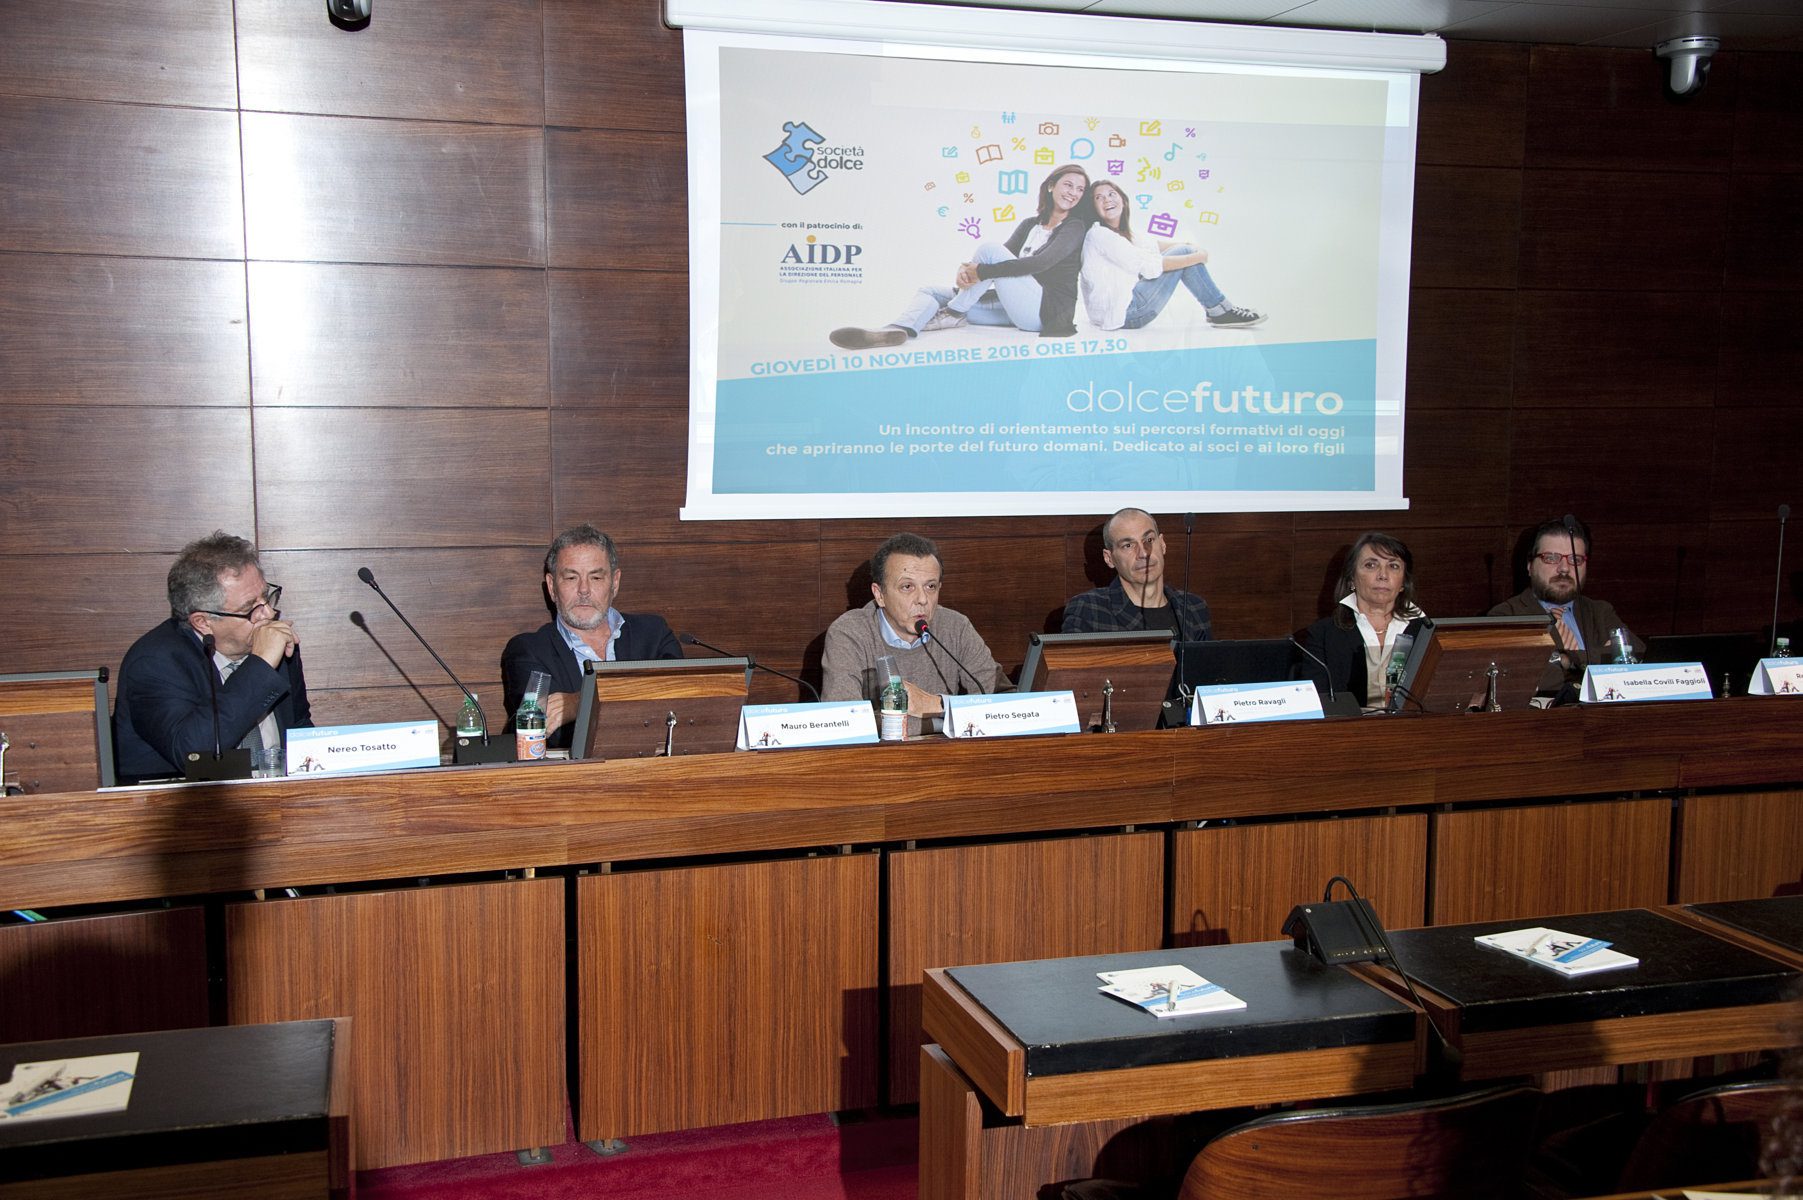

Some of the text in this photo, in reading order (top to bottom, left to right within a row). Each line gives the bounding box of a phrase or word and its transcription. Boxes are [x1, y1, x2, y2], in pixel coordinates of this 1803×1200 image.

[817, 146, 864, 157] società
[816, 156, 864, 170] dolce
[806, 222, 851, 230] patrocinio
[780, 235, 862, 265] AIDP
[750, 354, 837, 376] GIOVEDÌ
[842, 356, 864, 370] 10
[869, 347, 983, 368] NOVEMBRE
[987, 344, 1030, 360] 2016
[1035, 341, 1076, 356] ORE
[879, 422, 1345, 440] Un incontro di orientamento sui percorsi formativi di oggi
[766, 440, 1345, 457] che apriranno le porte del futuro domani. Dedicato ai soci e ai loro figli
[1676, 678, 1706, 686] Faggioli
[1258, 698, 1286, 706] Ravagli
[985, 711, 1040, 720] Pietro Segata
[809, 720, 850, 729] Berantelli
[327, 743, 397, 754] Nereo Tosatto
